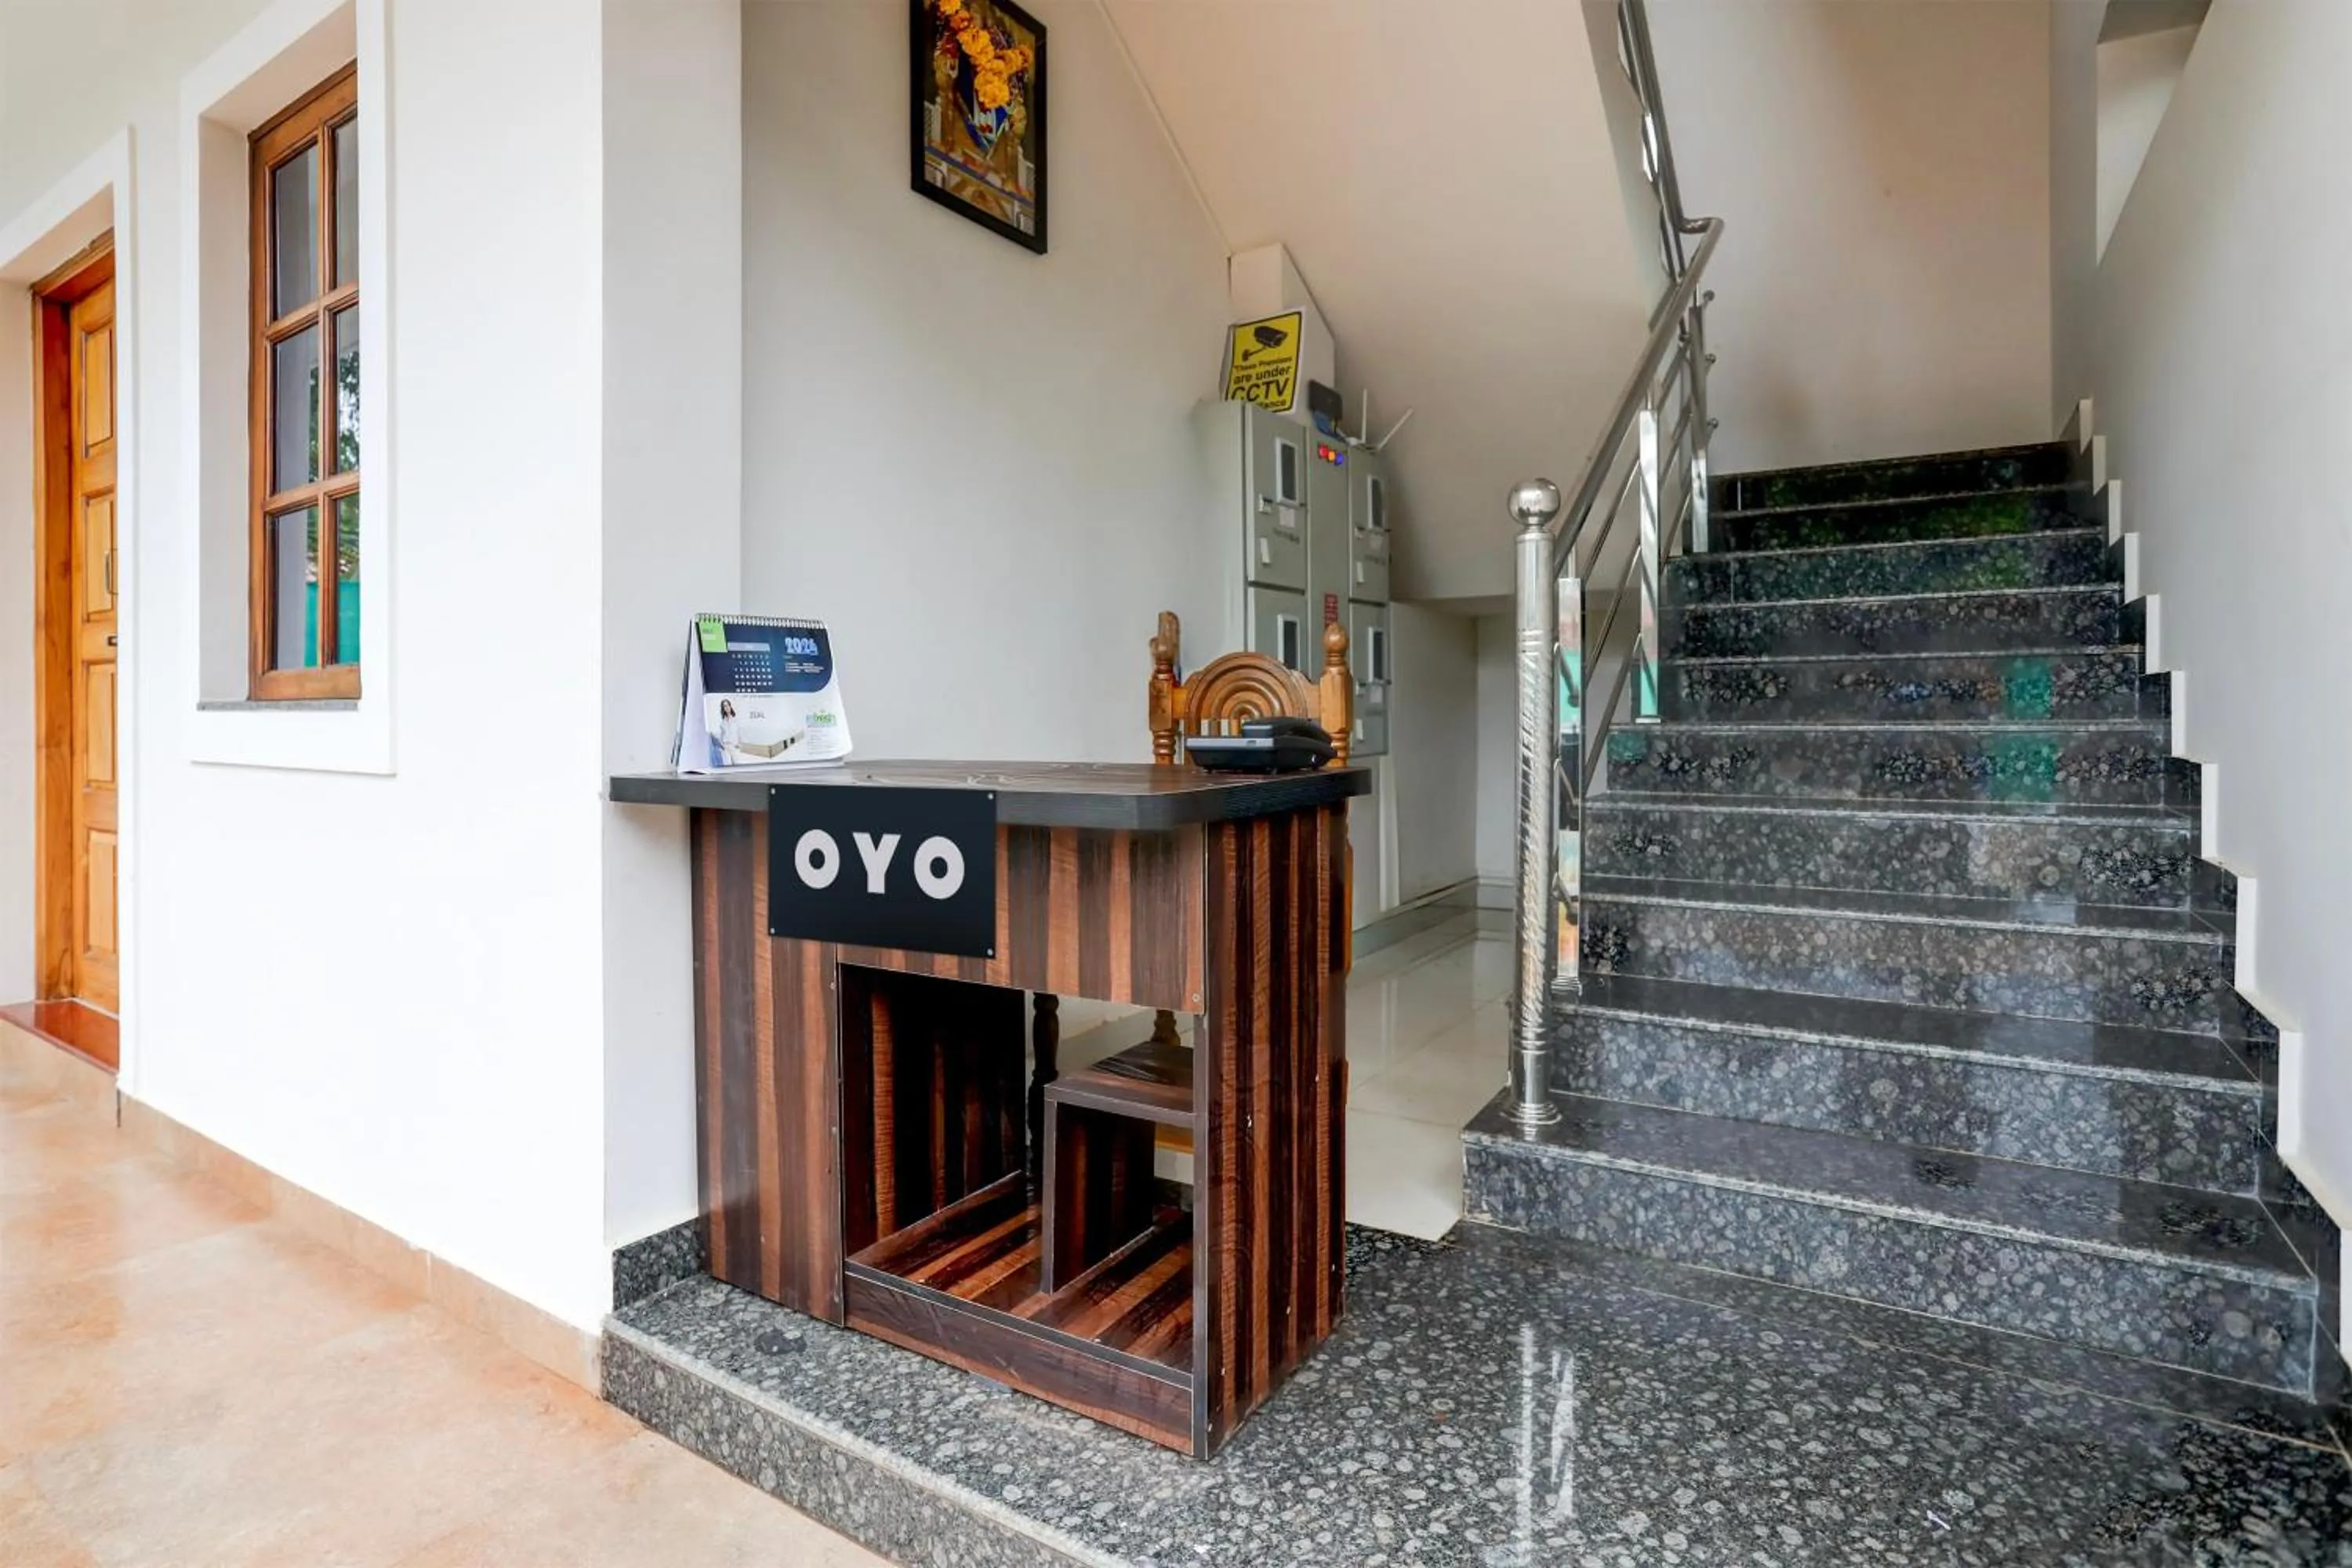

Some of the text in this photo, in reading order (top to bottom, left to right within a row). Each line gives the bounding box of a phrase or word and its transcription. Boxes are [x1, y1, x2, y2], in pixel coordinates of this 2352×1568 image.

[1234, 365, 1291, 386] are under
[1231, 377, 1289, 402] CCTV
[794, 829, 966, 900] OYO
